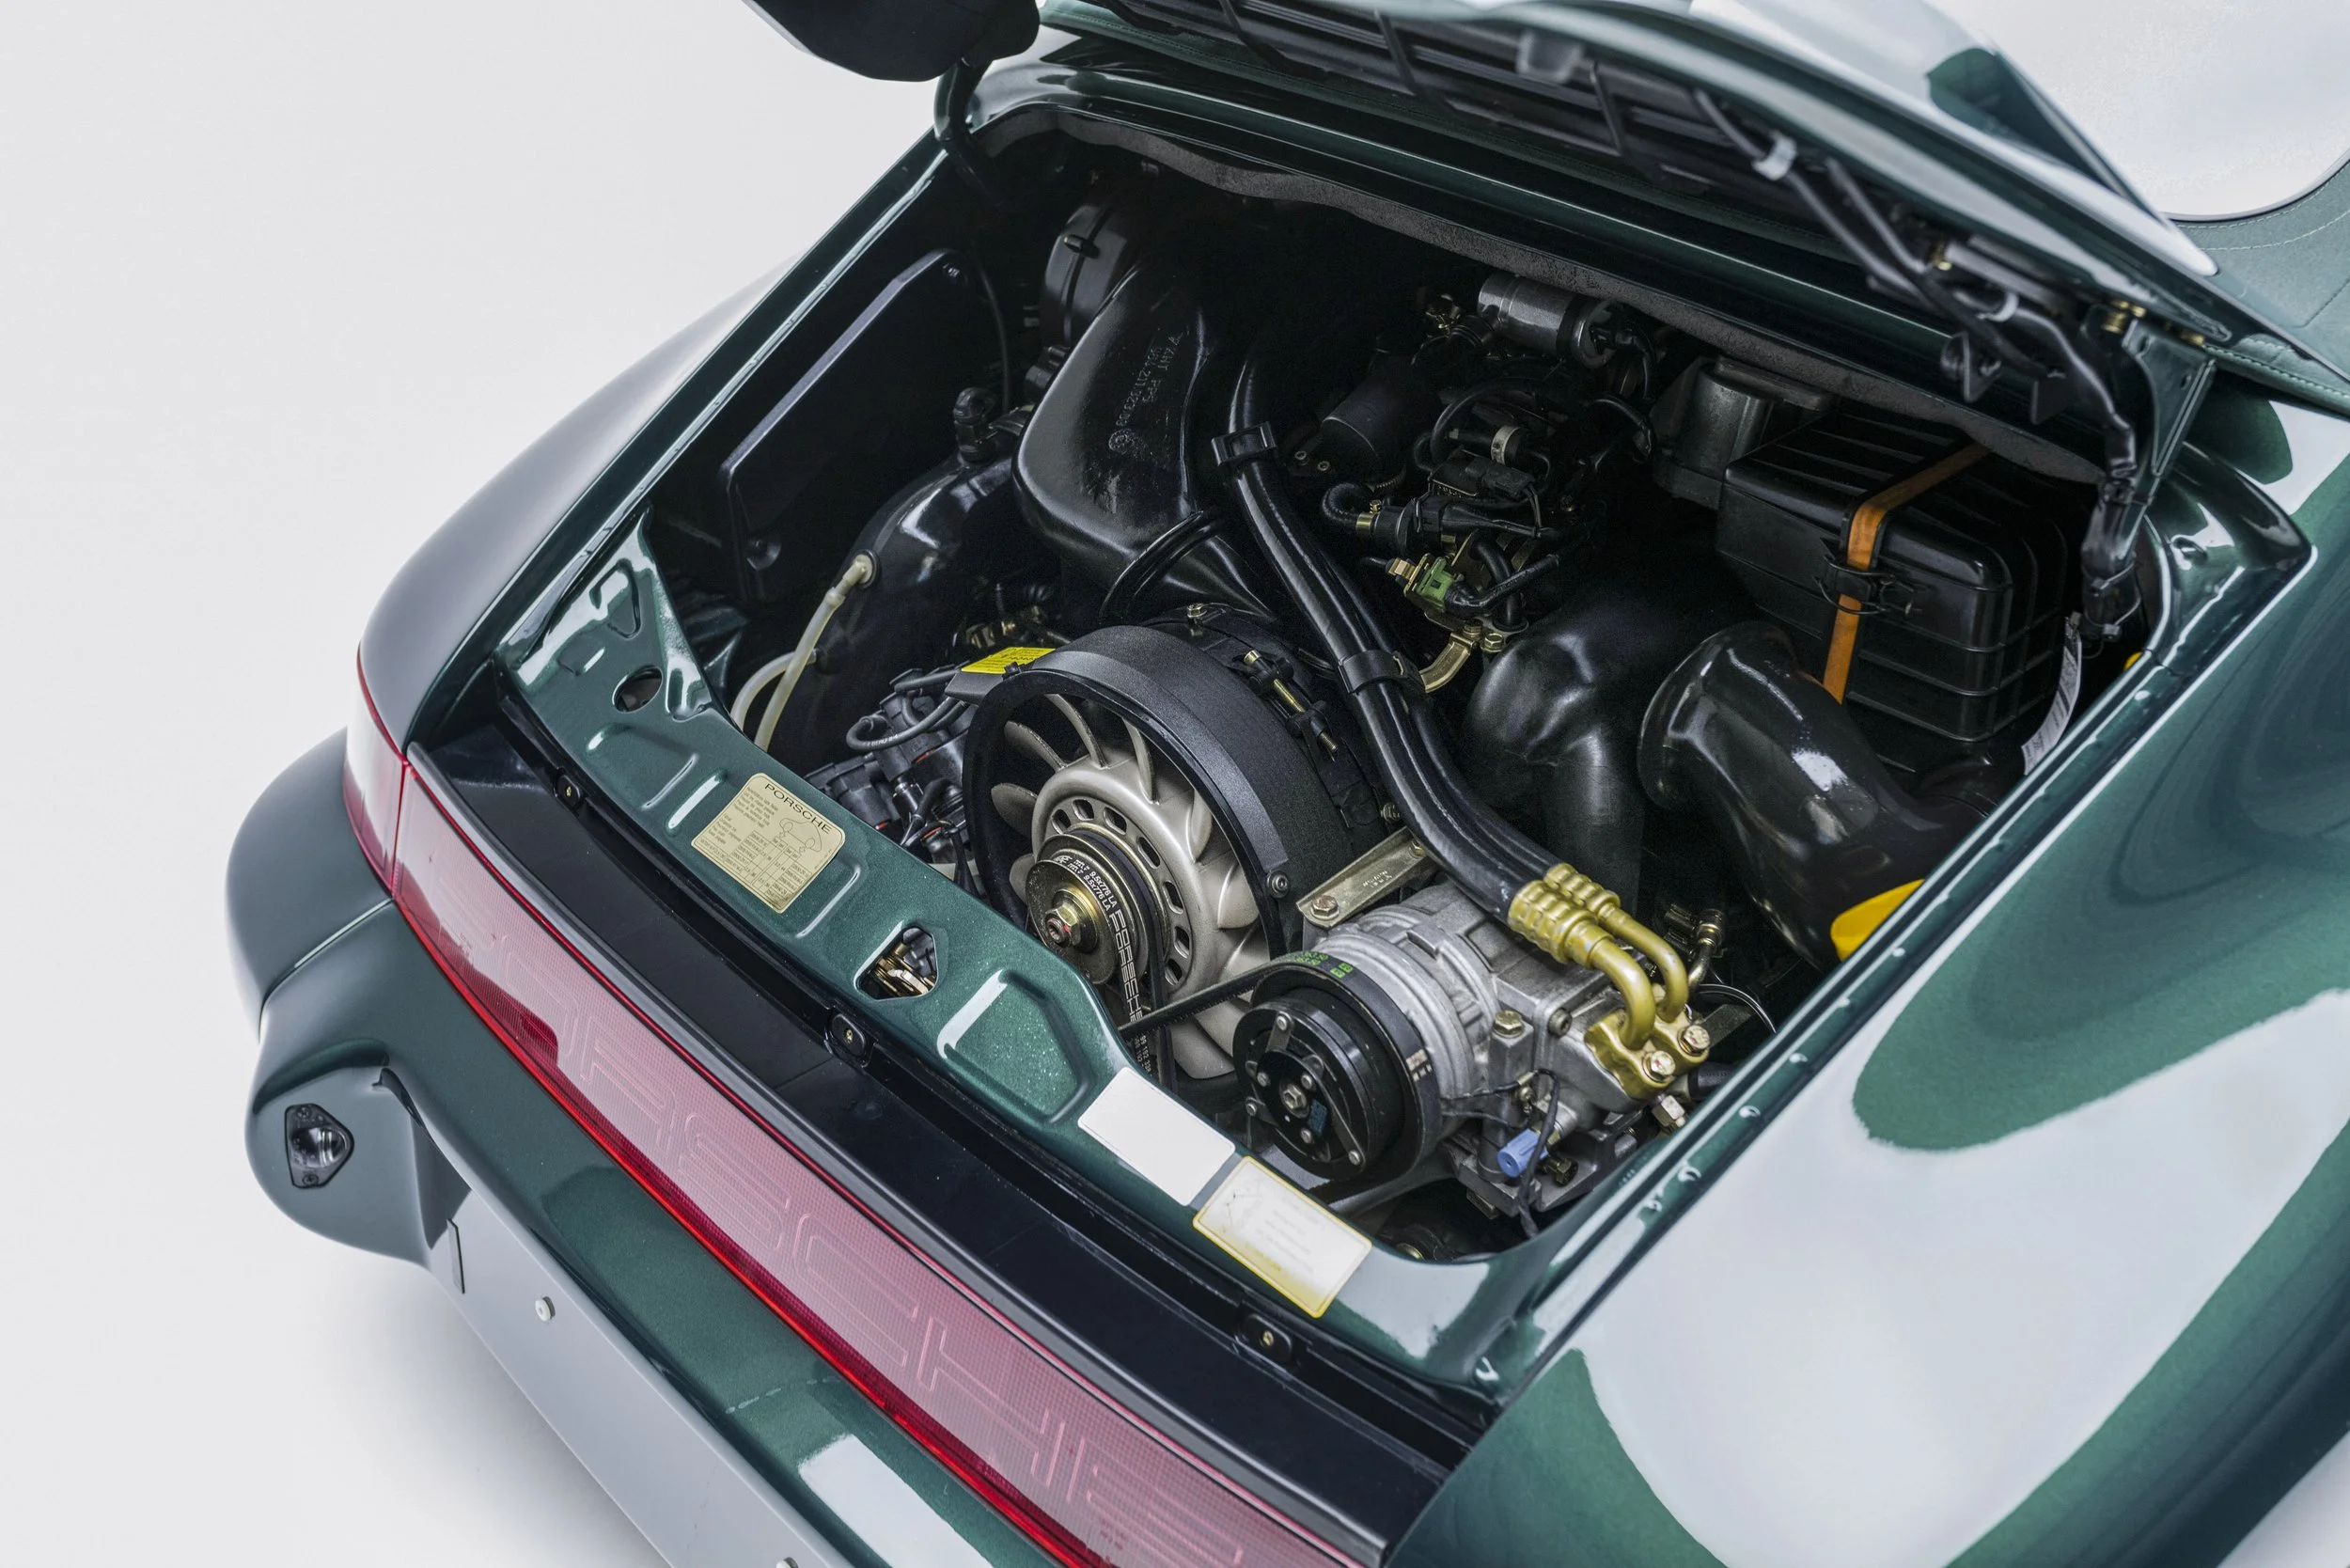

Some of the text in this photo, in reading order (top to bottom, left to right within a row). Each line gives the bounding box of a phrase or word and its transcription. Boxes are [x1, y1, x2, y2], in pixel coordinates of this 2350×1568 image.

[764, 782, 833, 836] PORSCHE
[1101, 899, 1112, 912] LA
[1108, 895, 1119, 908] LA
